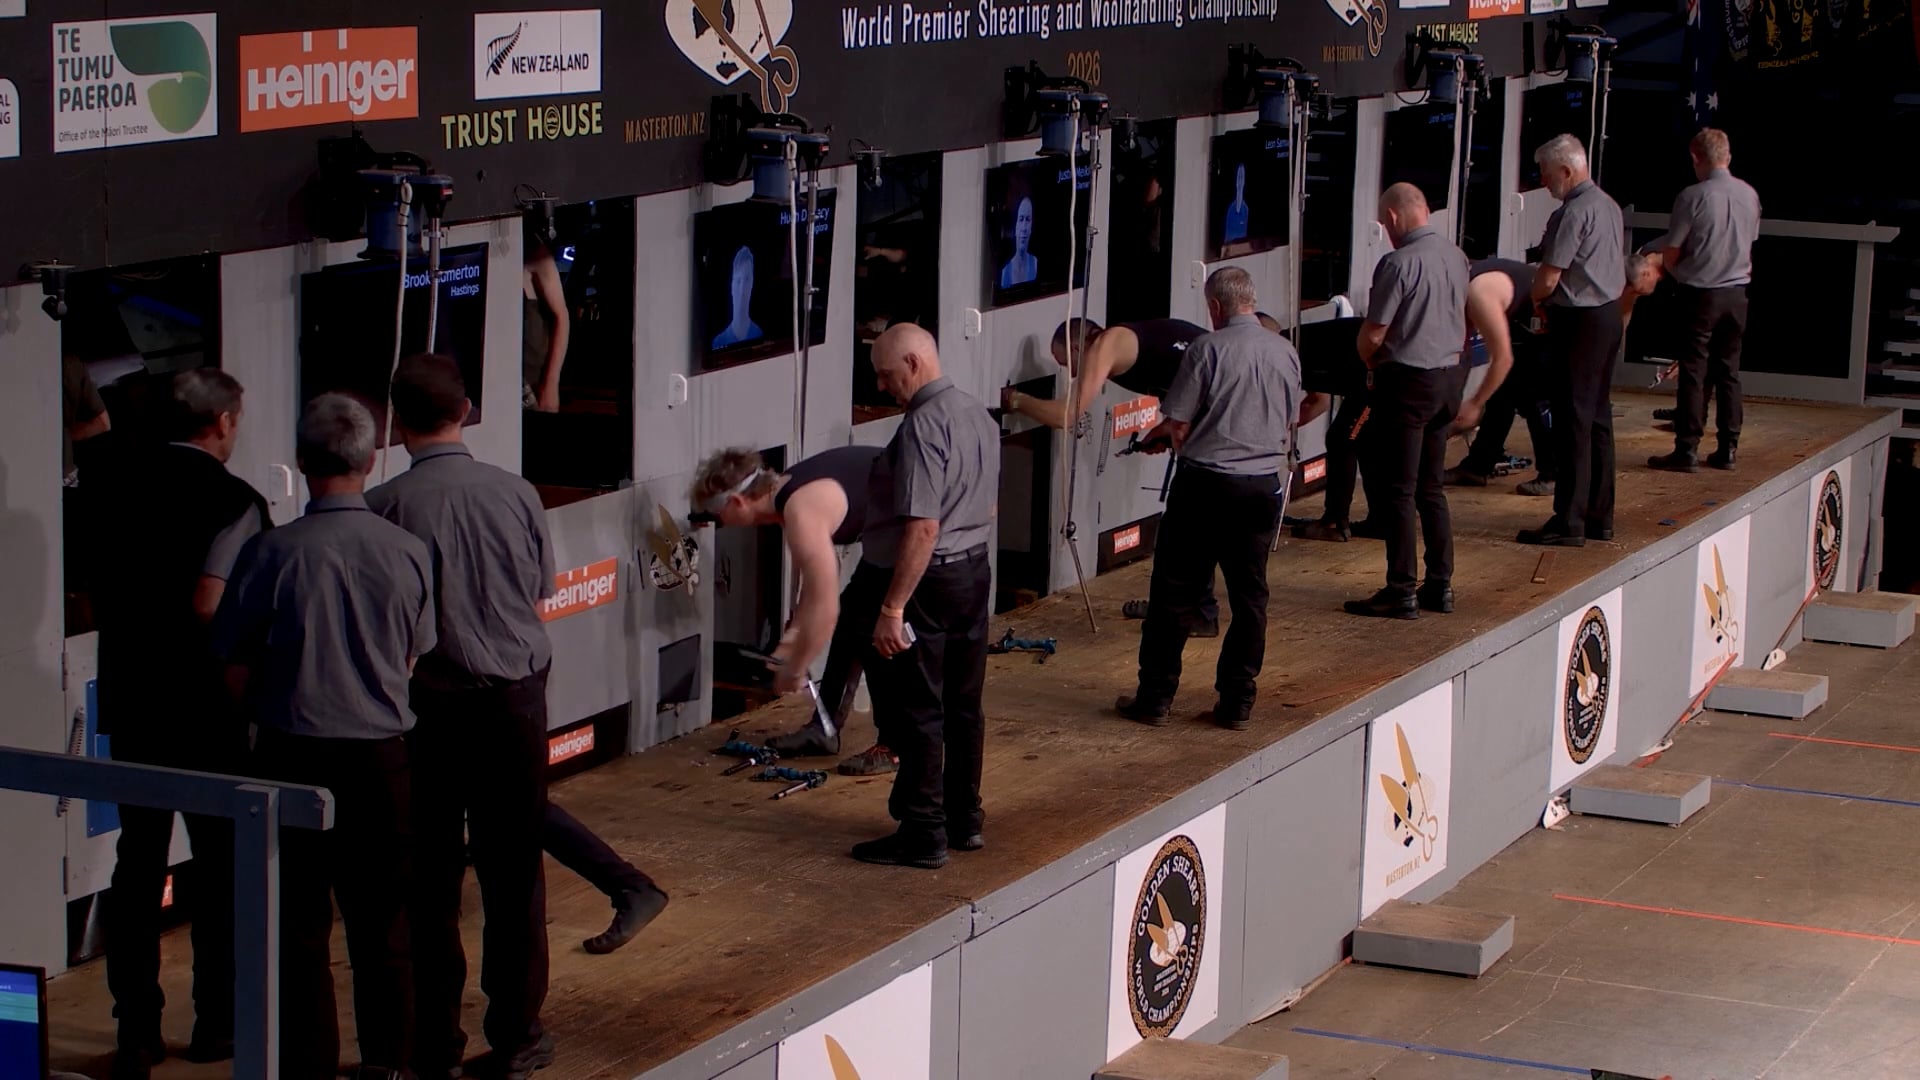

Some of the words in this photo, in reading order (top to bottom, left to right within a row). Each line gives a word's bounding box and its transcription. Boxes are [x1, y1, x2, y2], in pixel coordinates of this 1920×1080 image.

[842, 5, 892, 49] World
[902, 2, 970, 43] Premier
[978, 0, 1050, 39] Shearing
[1056, 0, 1083, 30] and
[1450, 22, 1479, 43] HOUSE
[58, 28, 80, 53] TE
[58, 54, 114, 83] TUMU
[248, 29, 414, 115] Heiniger
[511, 55, 537, 74] NEW
[538, 52, 589, 73] ZEALAND
[1067, 51, 1100, 86] 2026
[59, 82, 137, 112] PAEROA
[59, 129, 78, 142] Office
[80, 128, 87, 140] of
[88, 127, 100, 139] the
[122, 124, 148, 135] Trustee
[440, 108, 518, 150] TRUST
[527, 101, 603, 142] HOUSE
[624, 111, 708, 145] MASTERTON.NZ
[437, 264, 480, 284] amerton
[450, 283, 480, 297] Hastings
[1115, 400, 1157, 432] Heiniger
[551, 731, 594, 759] Heiniger
[1137, 860, 1170, 936] GOLDEN
[1172, 855, 1199, 906] SHEARS
[1135, 957, 1149, 1013] WORLD
[1148, 923, 1199, 1023] CHAMPIONSHIPS
